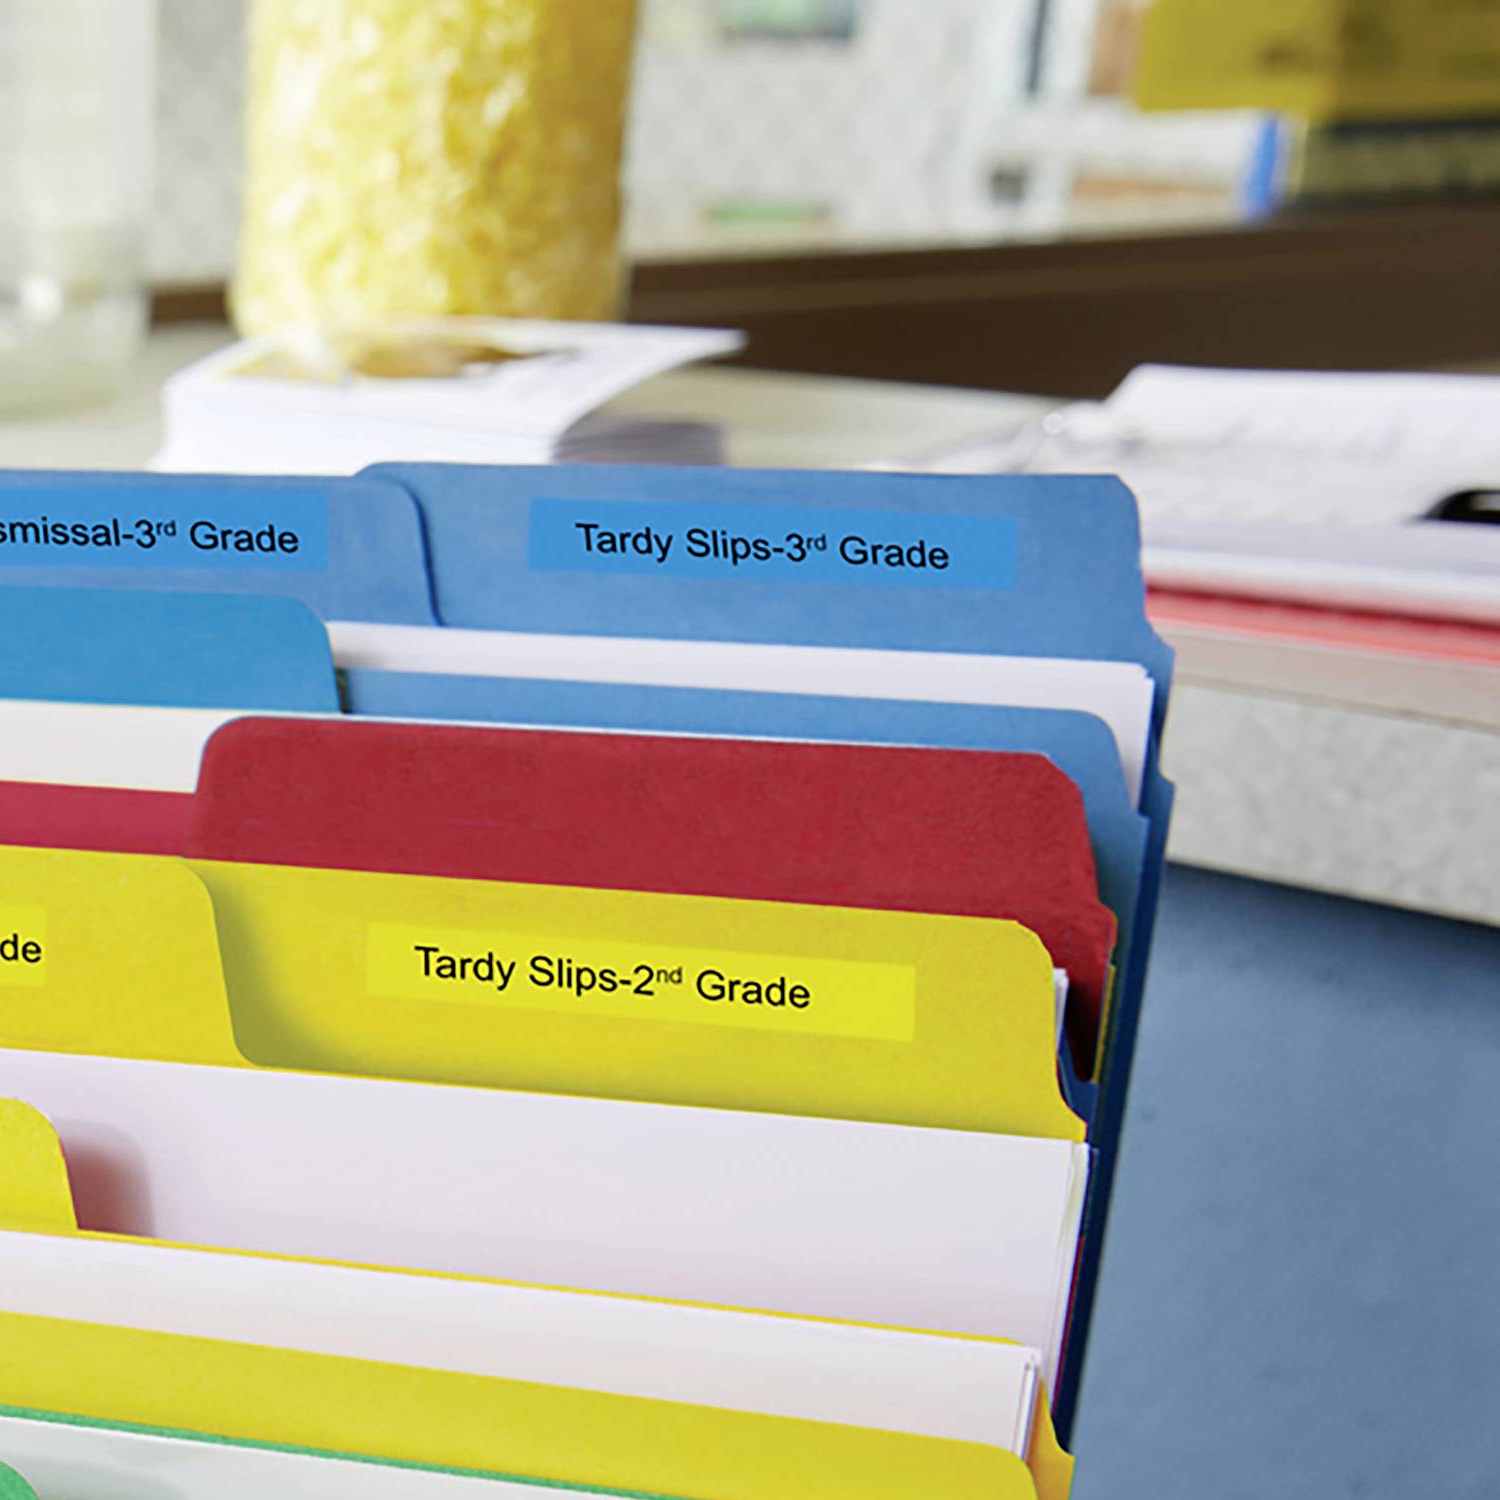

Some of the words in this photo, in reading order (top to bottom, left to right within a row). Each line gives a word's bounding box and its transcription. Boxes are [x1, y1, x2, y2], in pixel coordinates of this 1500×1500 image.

[189, 520, 299, 554] Grade
[575, 522, 673, 564] Tardy
[686, 528, 827, 566] Slips-3rd
[839, 535, 949, 570] Grade
[414, 945, 516, 992] Tardy
[528, 955, 683, 997] Slips-2nd
[696, 969, 811, 1009] Grade
